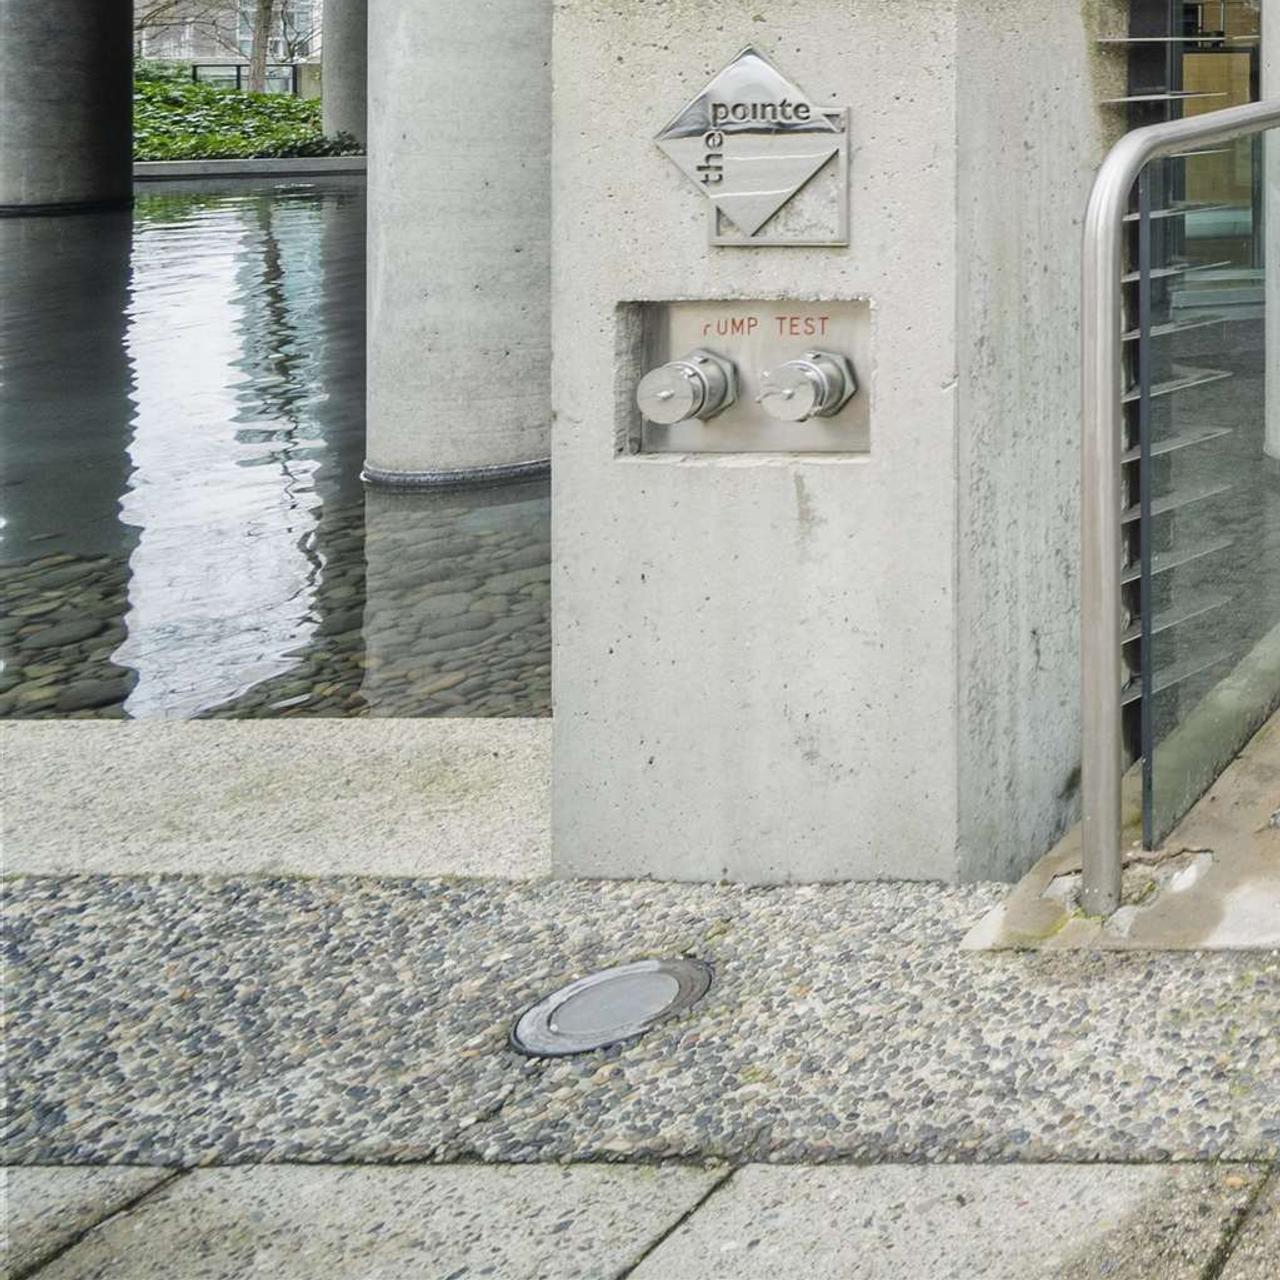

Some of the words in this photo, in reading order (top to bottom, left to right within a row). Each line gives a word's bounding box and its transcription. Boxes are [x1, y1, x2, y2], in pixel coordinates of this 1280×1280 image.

[711, 98, 811, 128] pointe
[696, 131, 724, 185] the
[775, 316, 829, 336] TEST
